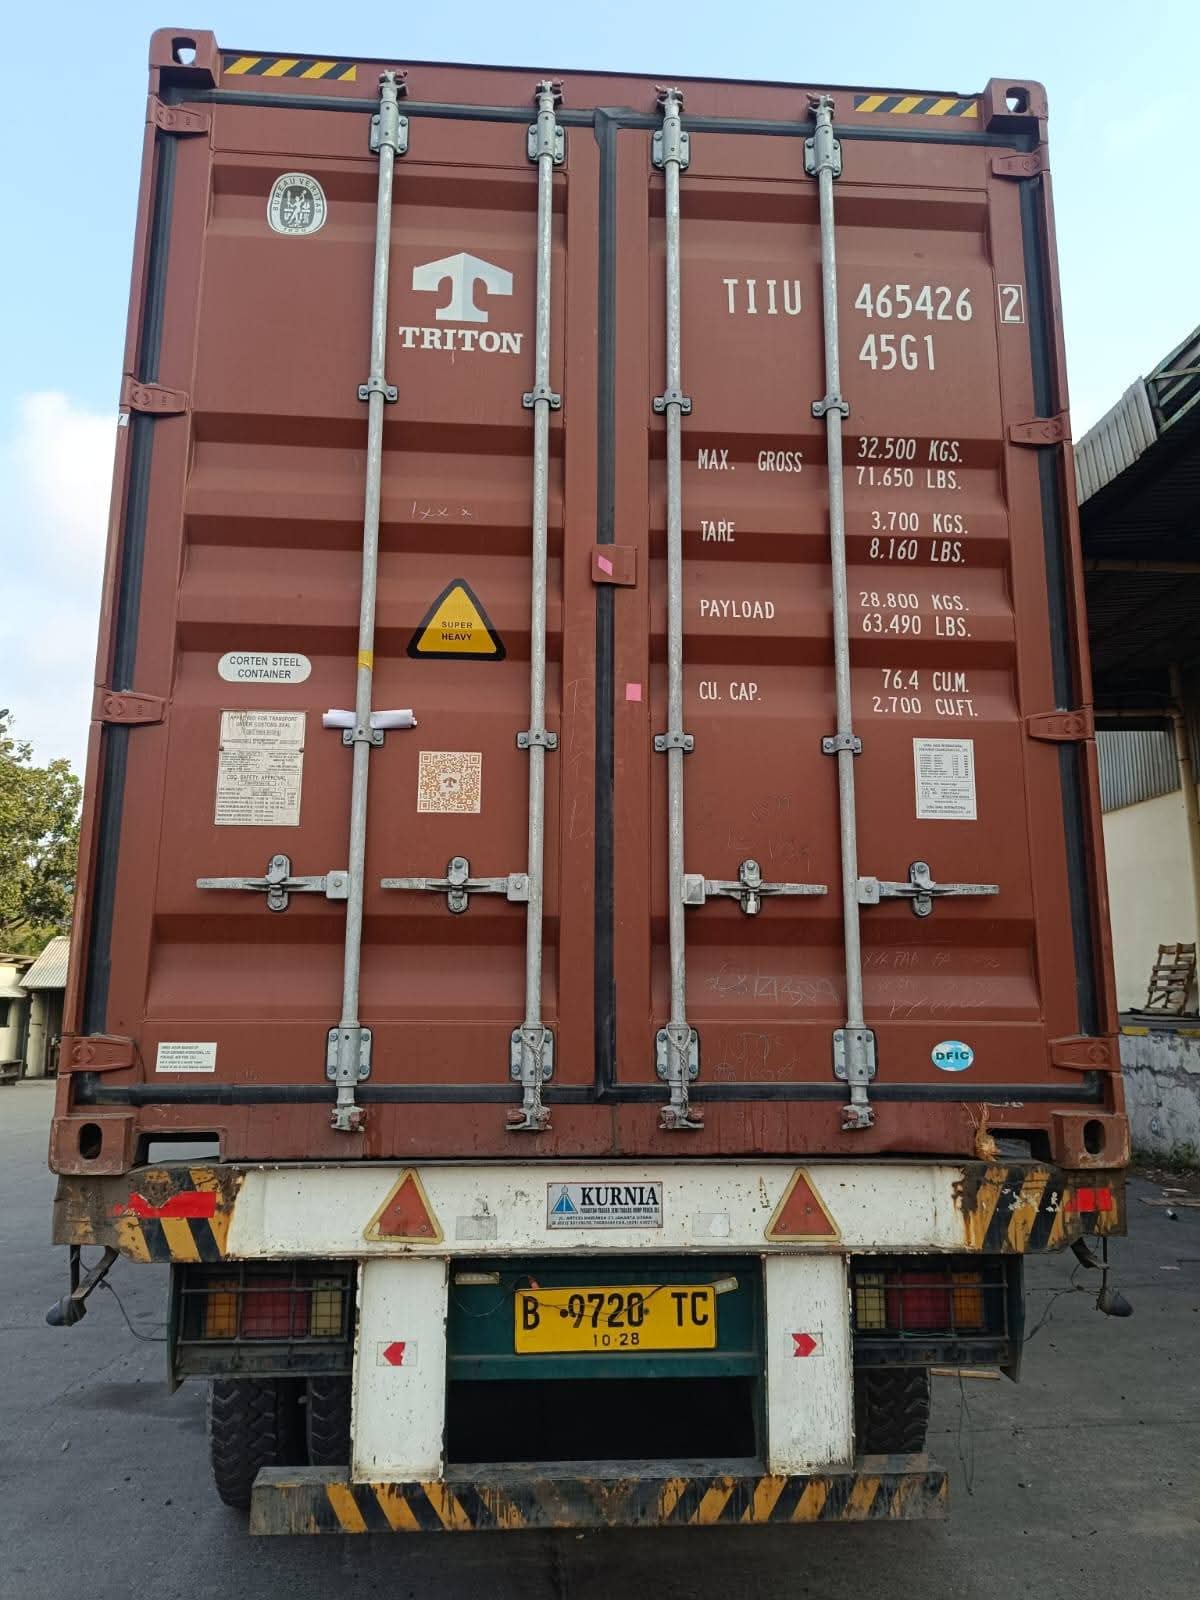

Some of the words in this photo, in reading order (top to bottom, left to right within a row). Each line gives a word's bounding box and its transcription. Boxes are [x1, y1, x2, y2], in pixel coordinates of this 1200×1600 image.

[272, 178, 295, 211] BUREAU
[299, 177, 322, 214] VERITAS
[723, 278, 803, 316] TIIU
[854, 283, 973, 322] 465426
[1002, 286, 1021, 322] 2
[399, 326, 524, 355] TRITON
[859, 334, 936, 371] 45G1
[698, 448, 736, 471] MAX.
[757, 450, 803, 473] GROSS
[928, 439, 963, 463] KGS.
[927, 468, 962, 490] LBS.
[700, 519, 736, 542] TARE
[932, 512, 969, 535] KGS.
[930, 540, 966, 563] LBS.
[700, 599, 775, 620] PAYLOAD
[931, 593, 970, 611] KGS.
[441, 620, 473, 629] SUPER
[935, 615, 972, 638] LBS.
[441, 632, 473, 641] HEAVY
[229, 656, 268, 666] CORTEN
[272, 657, 302, 667] STEEL
[238, 669, 292, 679] CONTAINER
[881, 668, 920, 690] 76.4
[932, 671, 970, 693] CU.M.
[699, 682, 721, 701] CU.
[729, 682, 762, 702] CAP.
[935, 698, 979, 717] CU.FT.
[935, 1050, 970, 1061] DFIC
[580, 1186, 660, 1206] KURNIA
[522, 1295, 540, 1330] B
[567, 1291, 645, 1329] 9720
[670, 1291, 709, 1327] TC
